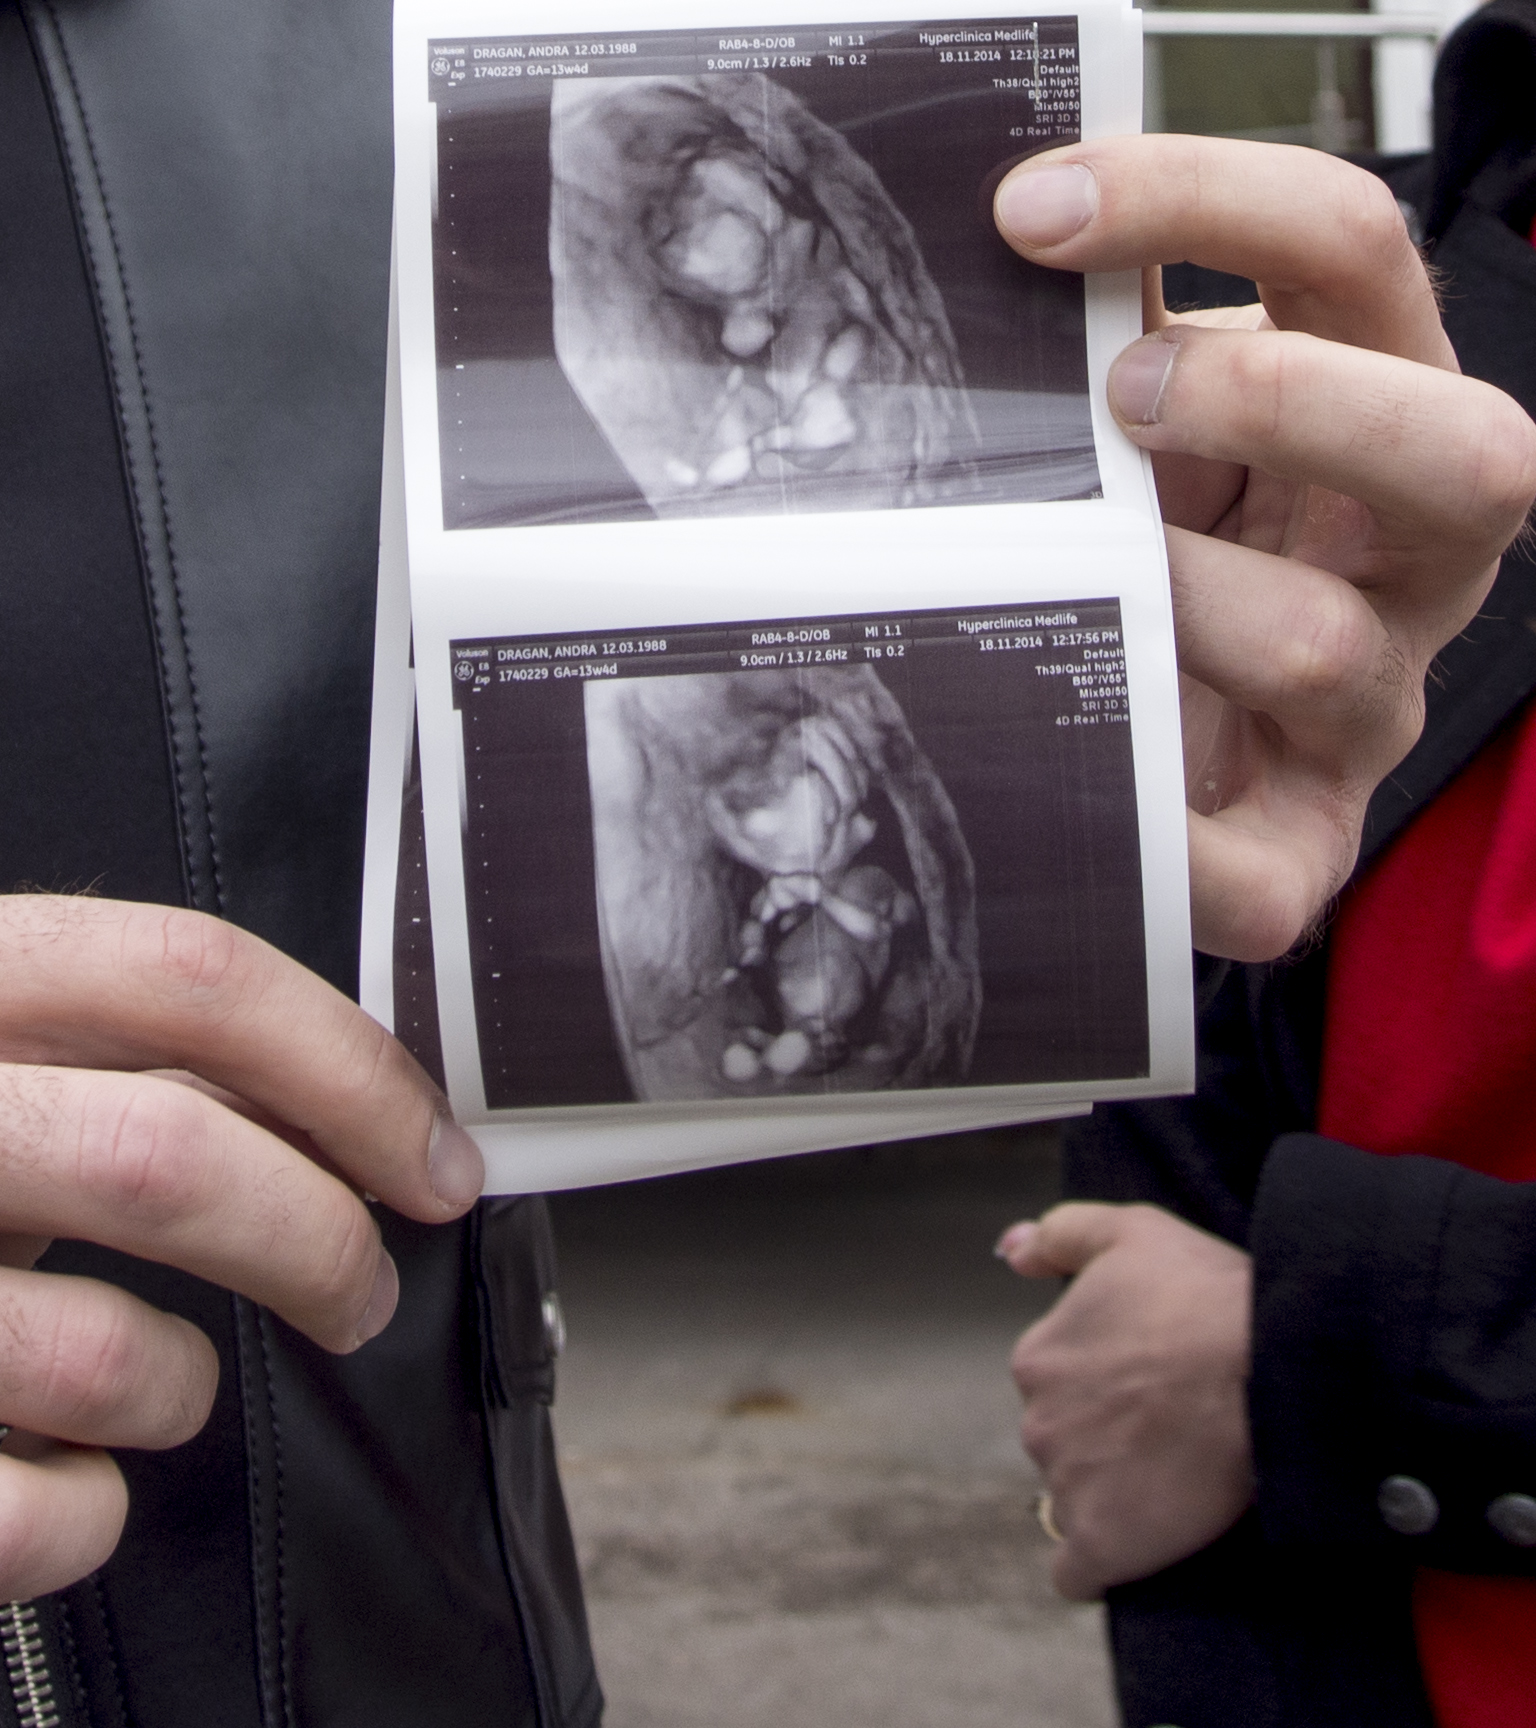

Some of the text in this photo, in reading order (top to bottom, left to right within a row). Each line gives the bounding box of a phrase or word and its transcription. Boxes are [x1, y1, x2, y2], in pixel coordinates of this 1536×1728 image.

[718, 37, 796, 50] RAB4-8-D/OB
[828, 35, 864, 46] MI 1.1
[919, 30, 1037, 45] Hyperclinica Medlife
[473, 43, 637, 59] DRAGAN, ANDRA 12.03.1988
[939, 51, 1001, 63] 18.11.2014
[1059, 48, 1075, 59] PM
[707, 58, 742, 70] 9.0cm
[753, 57, 770, 68] 1.3
[779, 56, 812, 68] 2.6Hz
[849, 54, 867, 65] 0.2
[450, 71, 466, 80] Exp
[473, 63, 588, 78] 1740229 GA=13w4d
[1040, 65, 1079, 74] Default
[1050, 77, 1079, 88] high2
[1057, 113, 1070, 122] 3D
[1074, 112, 1080, 122] 3
[1009, 126, 1080, 136] 4D Real Time
[958, 613, 1078, 634] Hyperclinica Medlife
[751, 630, 831, 645] RAB4-8-D/OB
[865, 625, 902, 638] MI 1.1
[979, 632, 1119, 651] 18.11.2014 12:17:56 PM
[497, 641, 667, 661] DRAGAN, ANDRA 12.03.1988
[886, 645, 905, 656] 0.2
[1083, 648, 1125, 660] Default
[740, 654, 776, 667] 9.0cm
[787, 652, 804, 664] 1.3
[814, 648, 848, 662] 2.6Hz
[1094, 660, 1125, 672] high2
[499, 664, 617, 682] 1740229 GA=13w4d
[474, 675, 491, 685] Exp
[1104, 700, 1118, 709] 3D
[1122, 699, 1128, 708] 3
[1055, 713, 1129, 726] 4D Real Time
